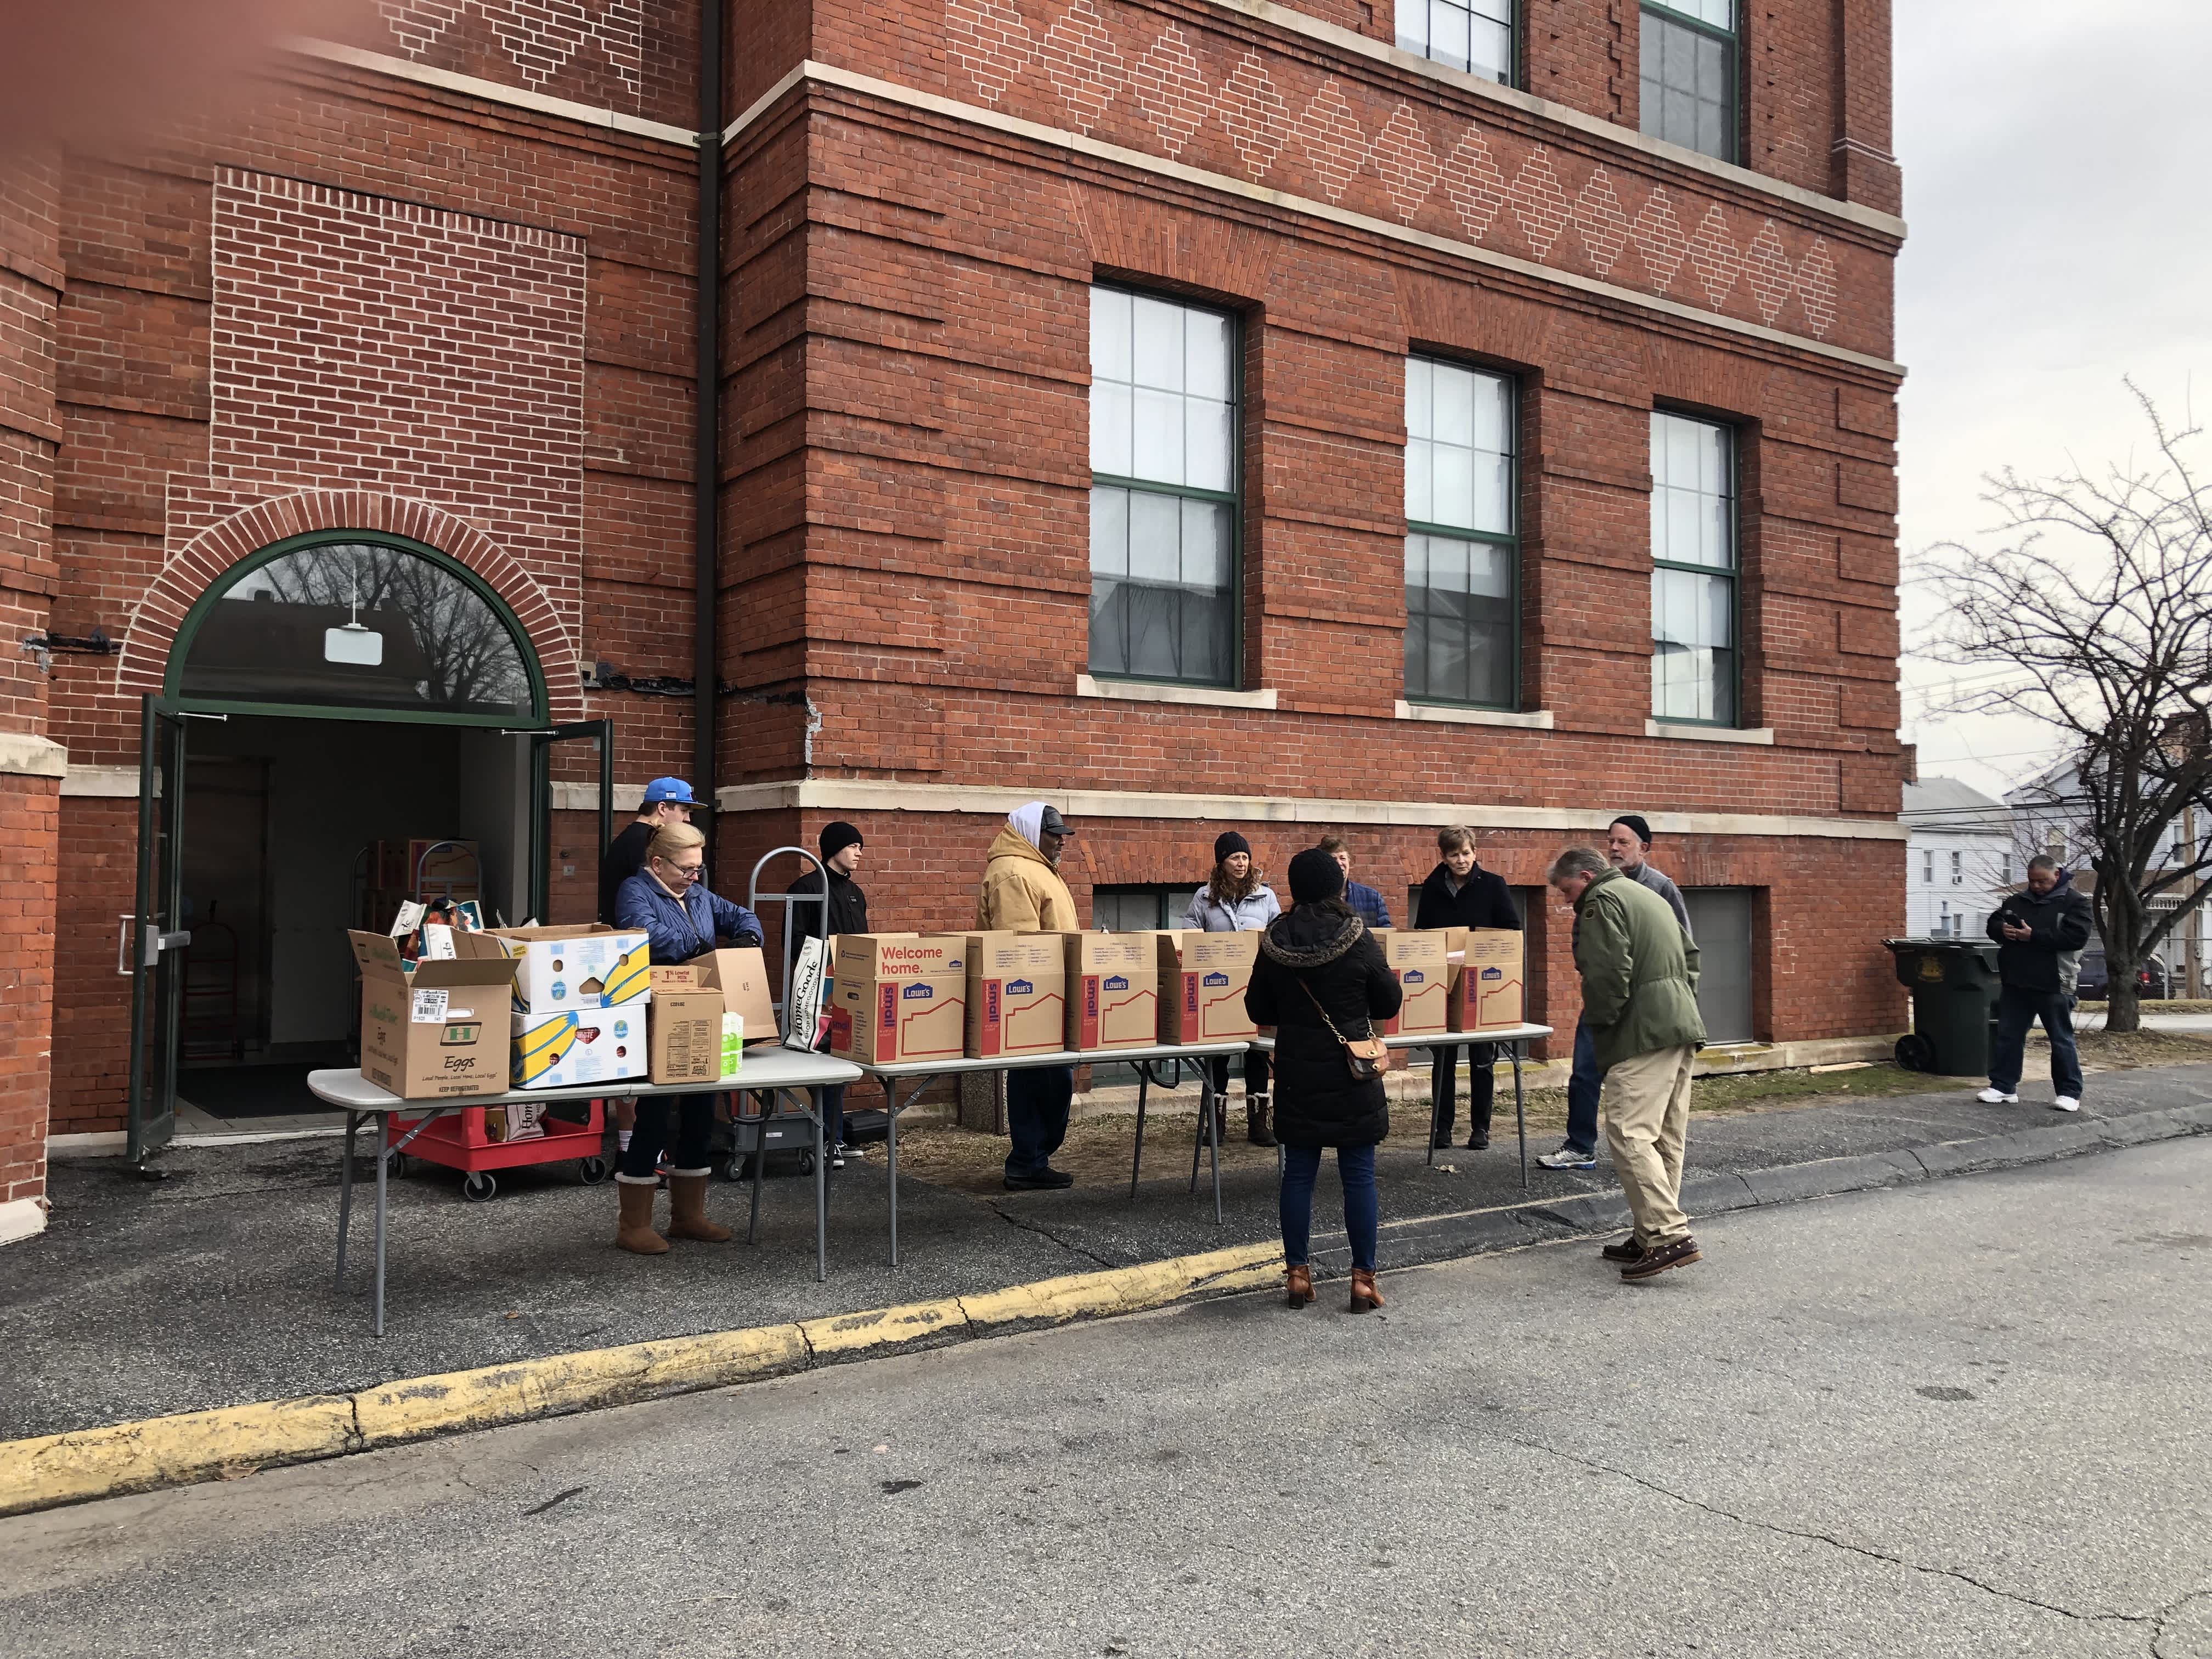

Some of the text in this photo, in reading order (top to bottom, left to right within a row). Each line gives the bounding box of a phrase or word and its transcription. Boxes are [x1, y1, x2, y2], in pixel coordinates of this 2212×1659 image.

[881, 946, 943, 960] Welcome
[882, 962, 924, 975] home.
[1105, 981, 1126, 989] LOWE'S
[1205, 977, 1226, 985] LOWE'S
[906, 988, 930, 997] LOWE'S
[1008, 985, 1030, 994] LOWE'S
[1188, 976, 1197, 1012] small
[795, 961, 817, 1036] HomeGoods
[989, 984, 998, 1022] small
[1088, 979, 1097, 1017] small
[884, 987, 895, 1028] small
[448, 1027, 471, 1040] H
[444, 1056, 476, 1072] Eggs
[522, 1104, 533, 1129] Hom
